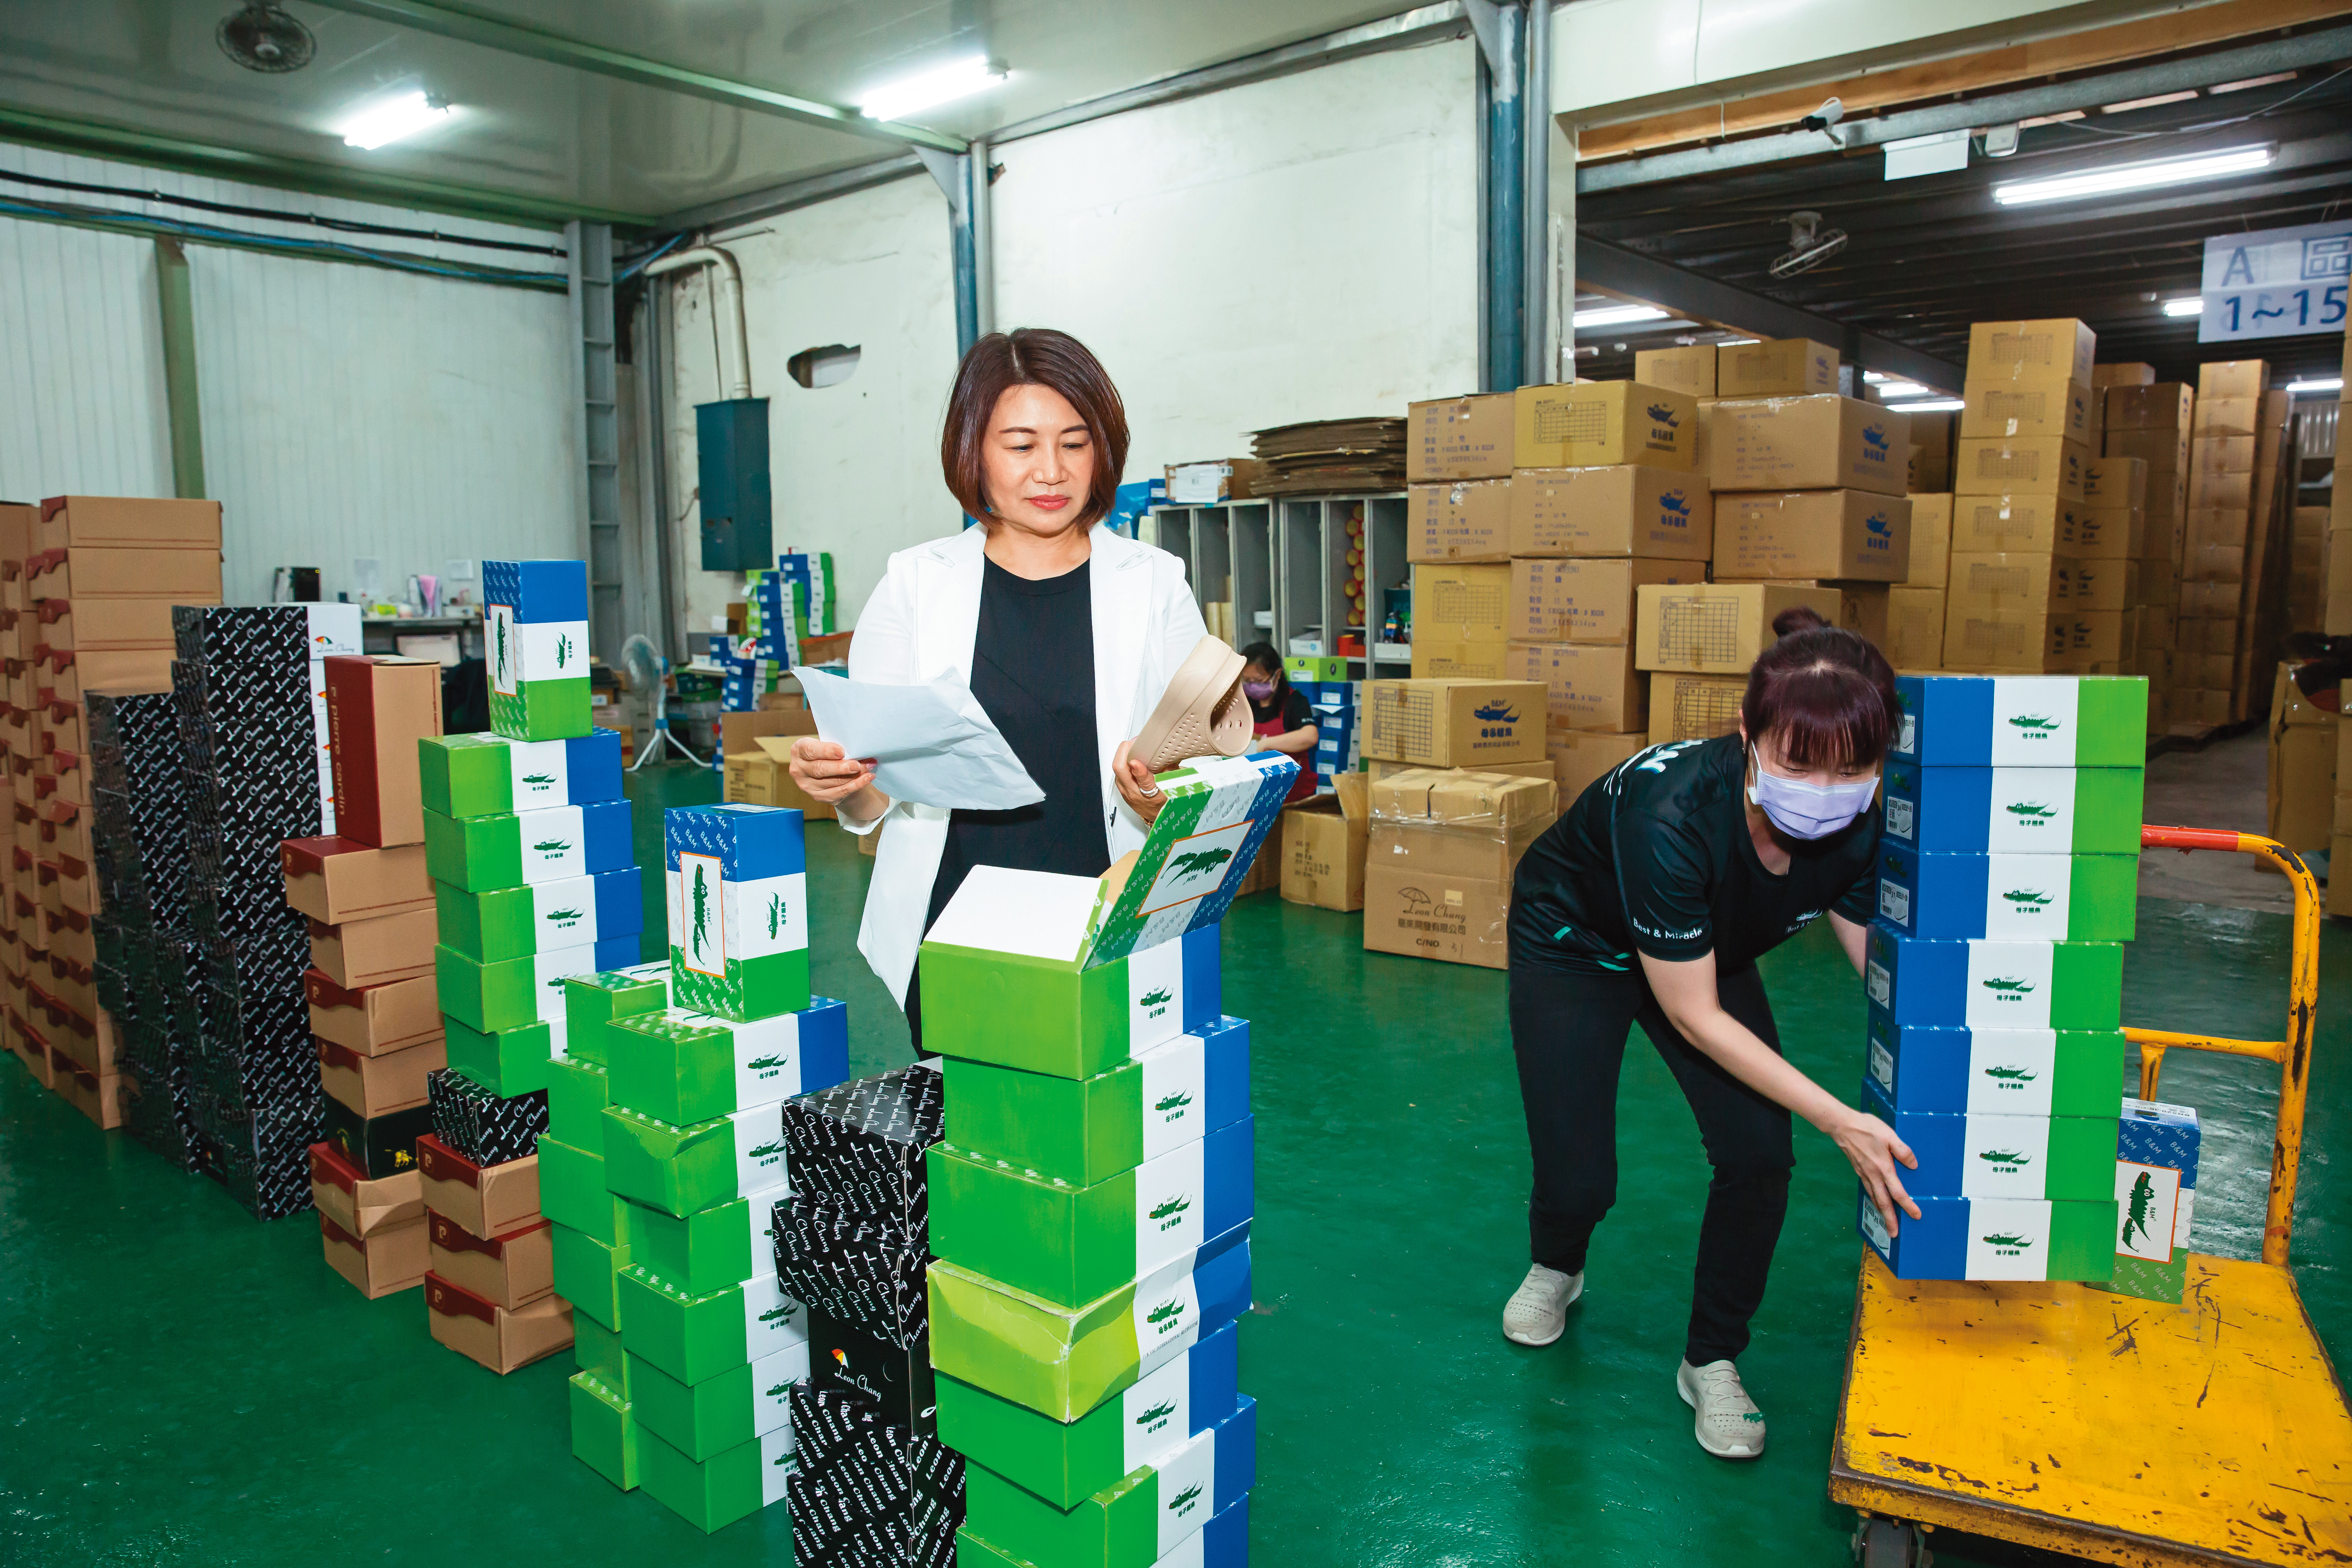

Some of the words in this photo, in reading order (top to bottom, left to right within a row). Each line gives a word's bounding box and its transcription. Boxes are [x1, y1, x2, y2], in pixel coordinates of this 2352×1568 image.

[2221, 245, 2255, 287] A
[1633, 917, 1650, 935] Best
[1653, 929, 1661, 938] &
[1665, 927, 1702, 940] Miracle
[887, 1172, 904, 1205] Chang
[1156, 1333, 1180, 1351] INTERNATIONAL
[835, 1368, 855, 1385] Leon
[857, 1374, 882, 1402] Chang
[798, 1392, 810, 1418] Leon
[795, 1437, 814, 1469] Chang
[875, 1468, 897, 1501] Chang
[940, 1458, 956, 1489] Leon
